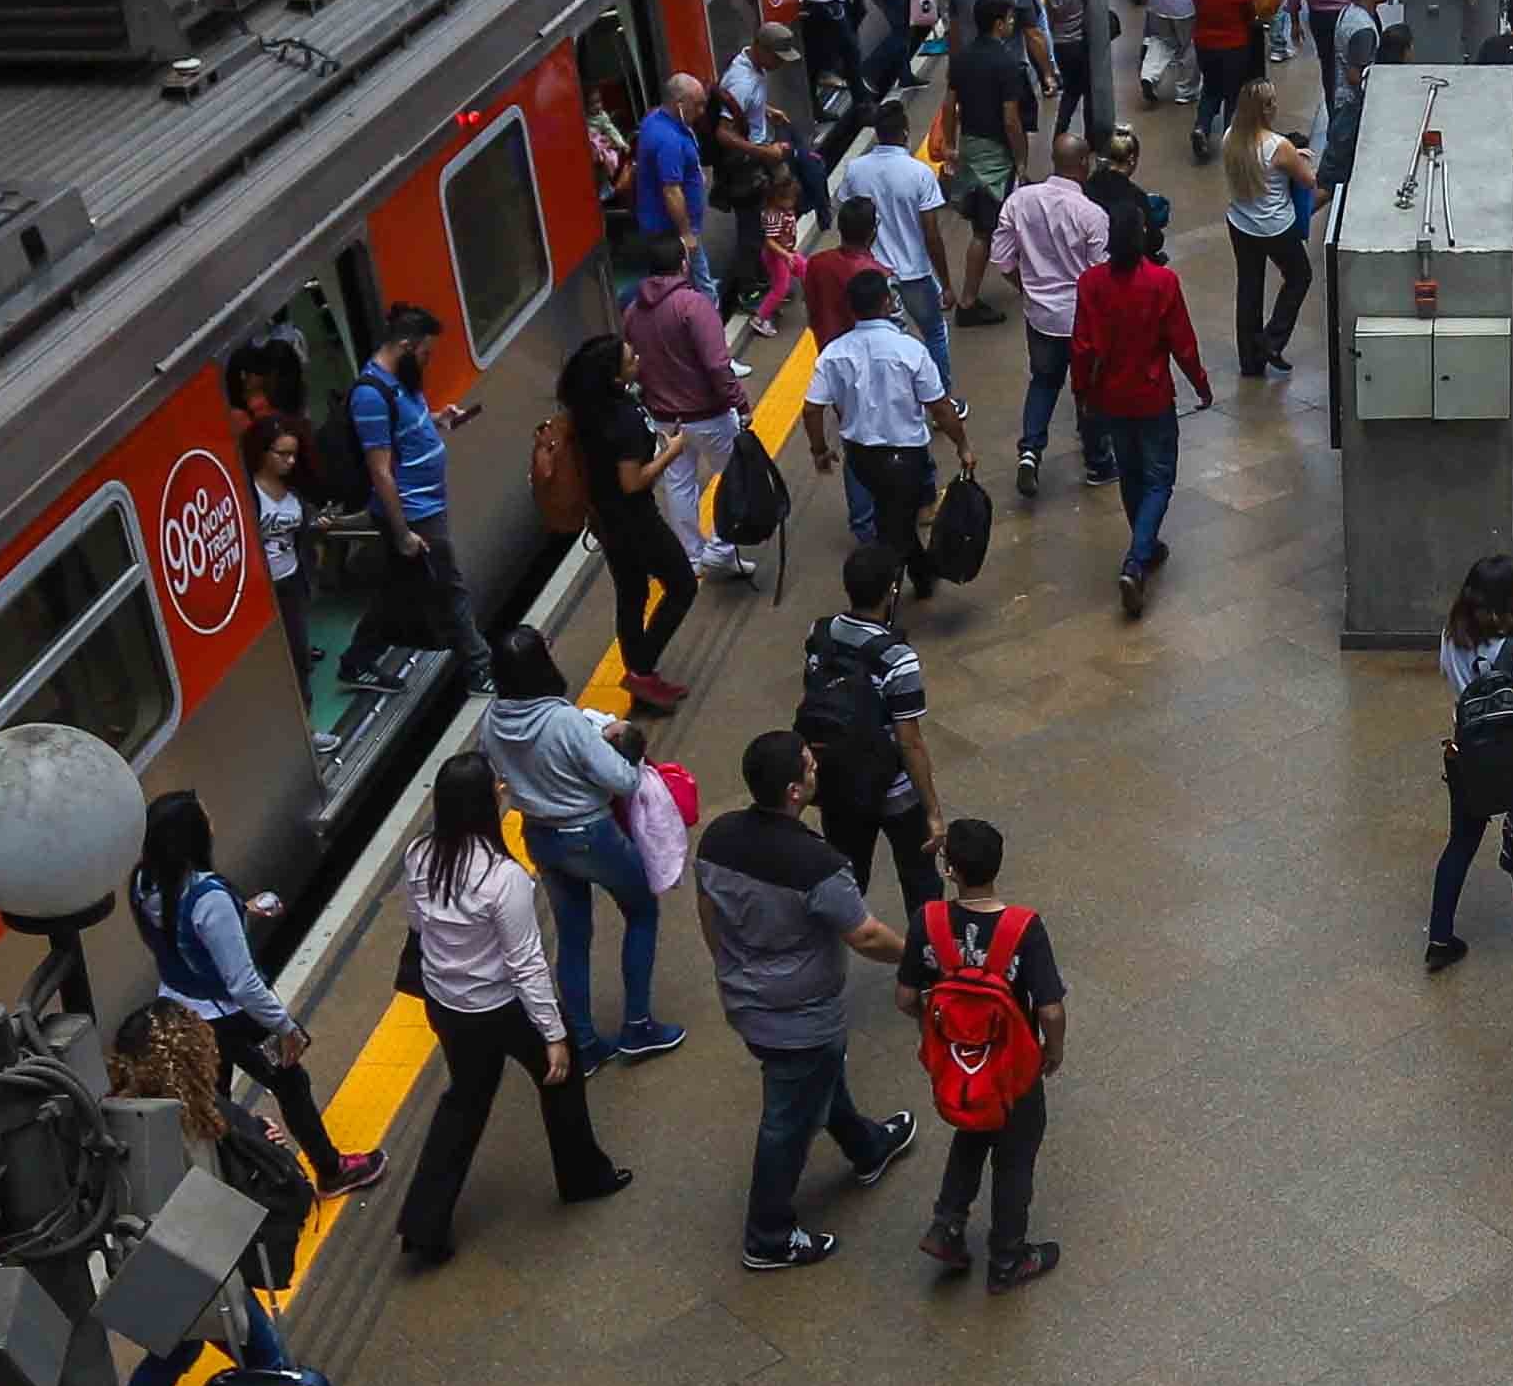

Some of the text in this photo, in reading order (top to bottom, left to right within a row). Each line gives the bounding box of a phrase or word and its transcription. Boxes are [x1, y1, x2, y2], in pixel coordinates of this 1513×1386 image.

[201, 495, 233, 540] NOVO
[206, 518, 238, 563] TREM
[212, 541, 241, 583] CPTM
